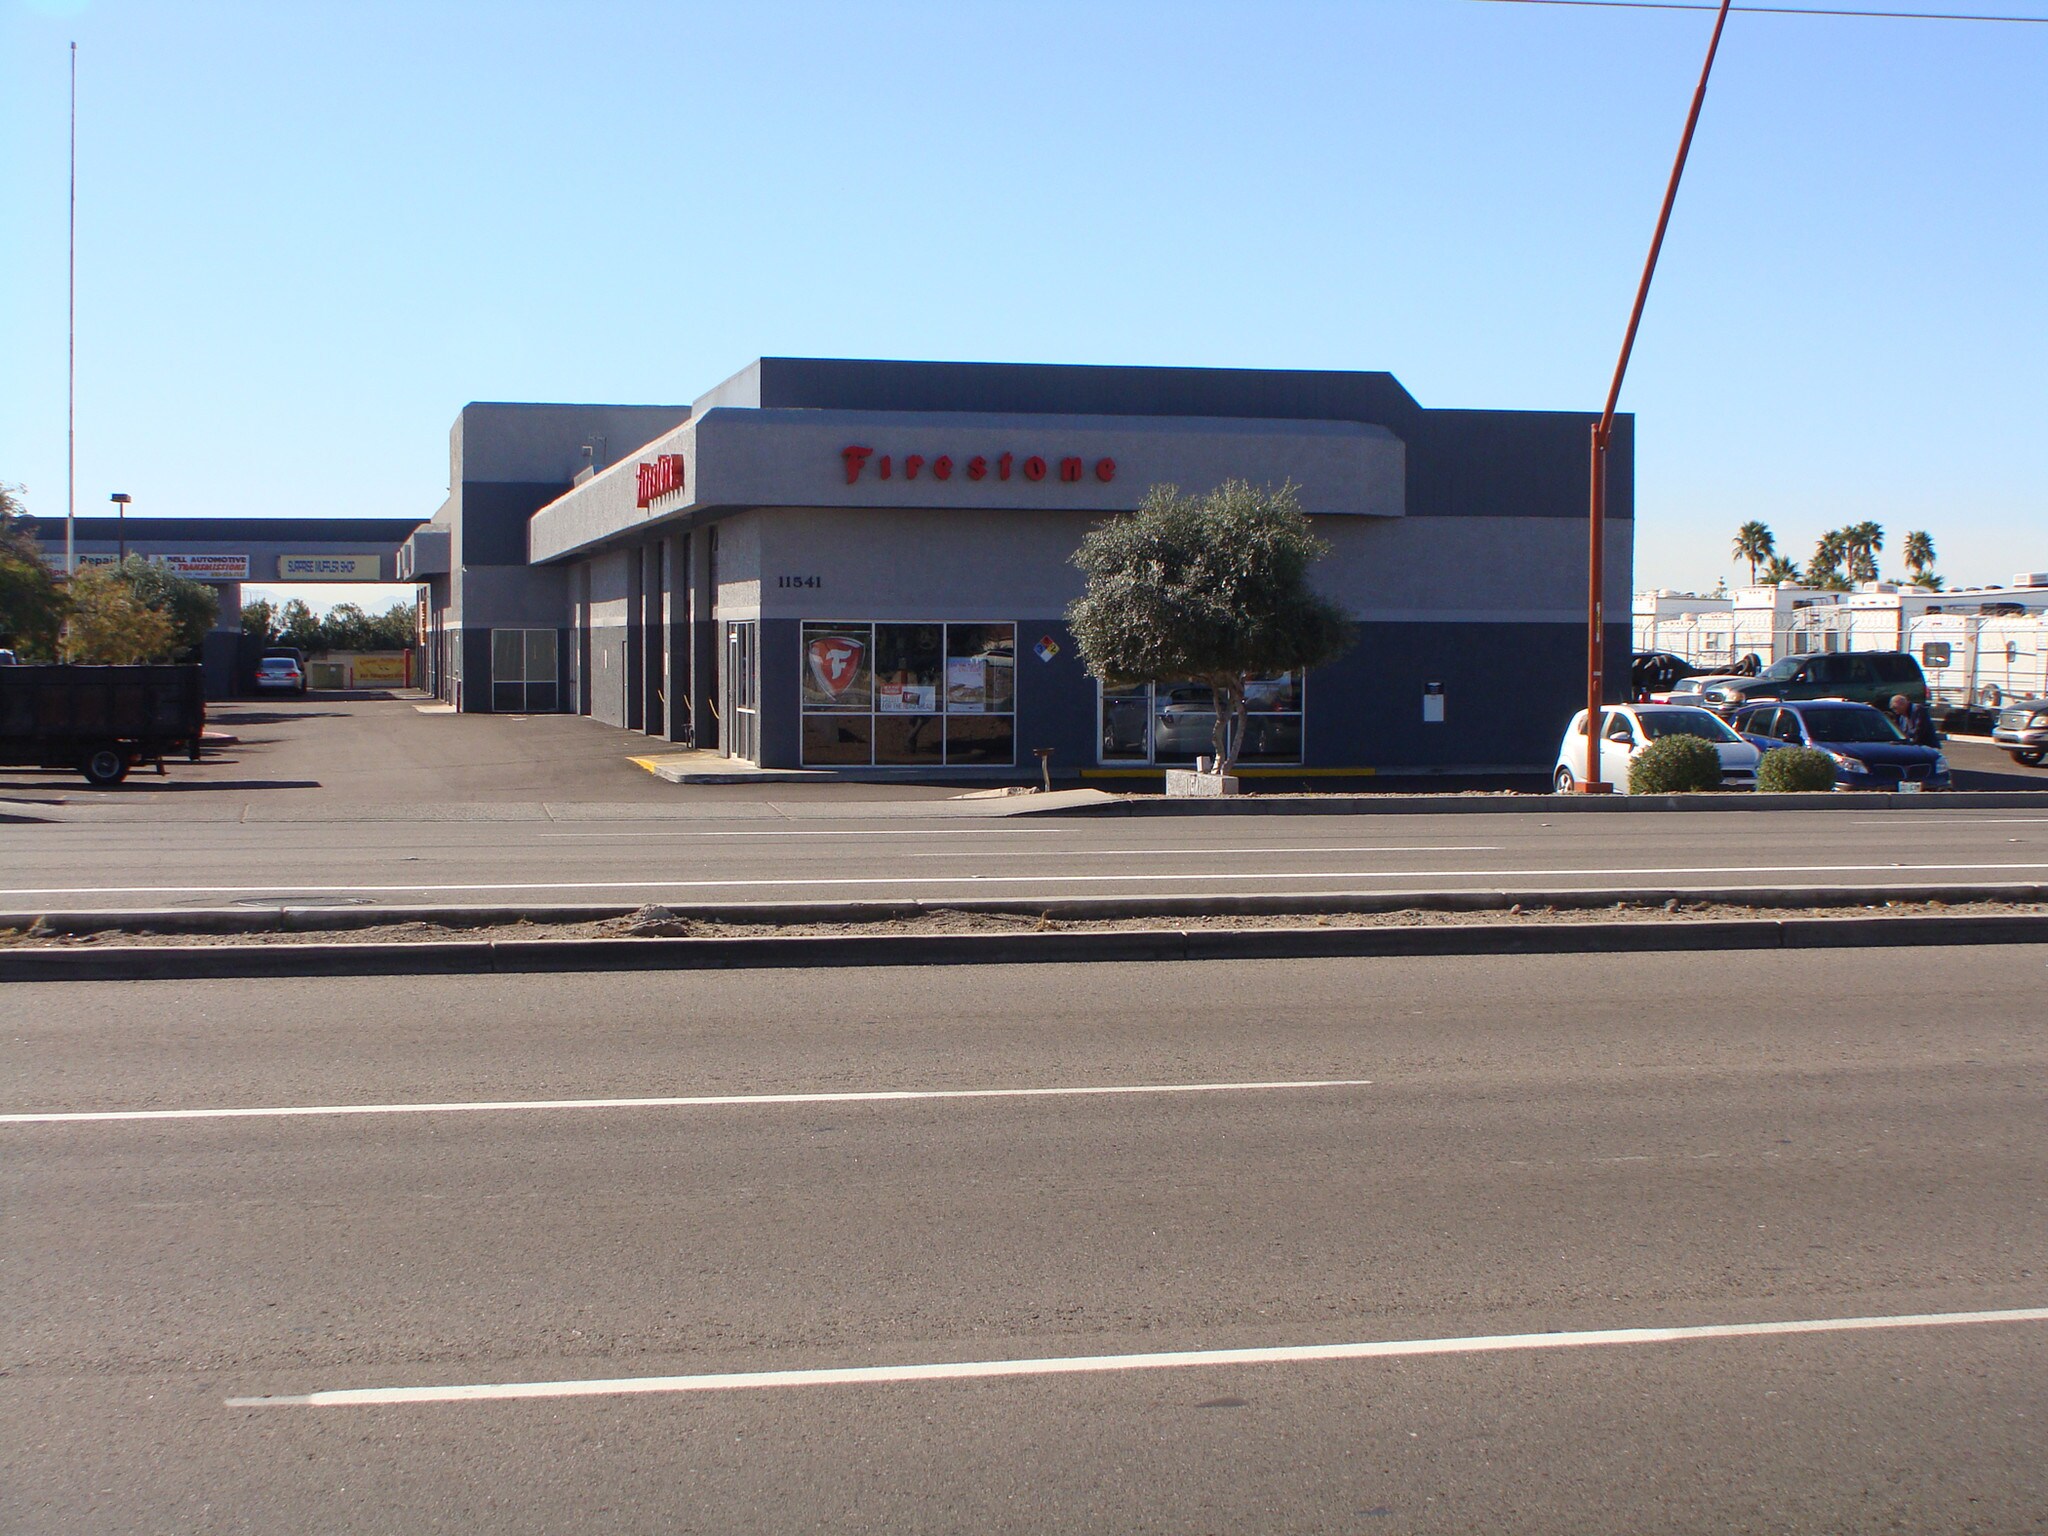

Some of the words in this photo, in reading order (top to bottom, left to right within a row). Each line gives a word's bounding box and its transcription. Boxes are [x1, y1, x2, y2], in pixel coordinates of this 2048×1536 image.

[841, 445, 1116, 485] Firestone
[177, 563, 247, 571] TRANSMISSIONS
[288, 559, 314, 573] SURPRISE
[340, 559, 356, 573] SHOP
[778, 575, 821, 588] 11541
[826, 648, 853, 680] F
